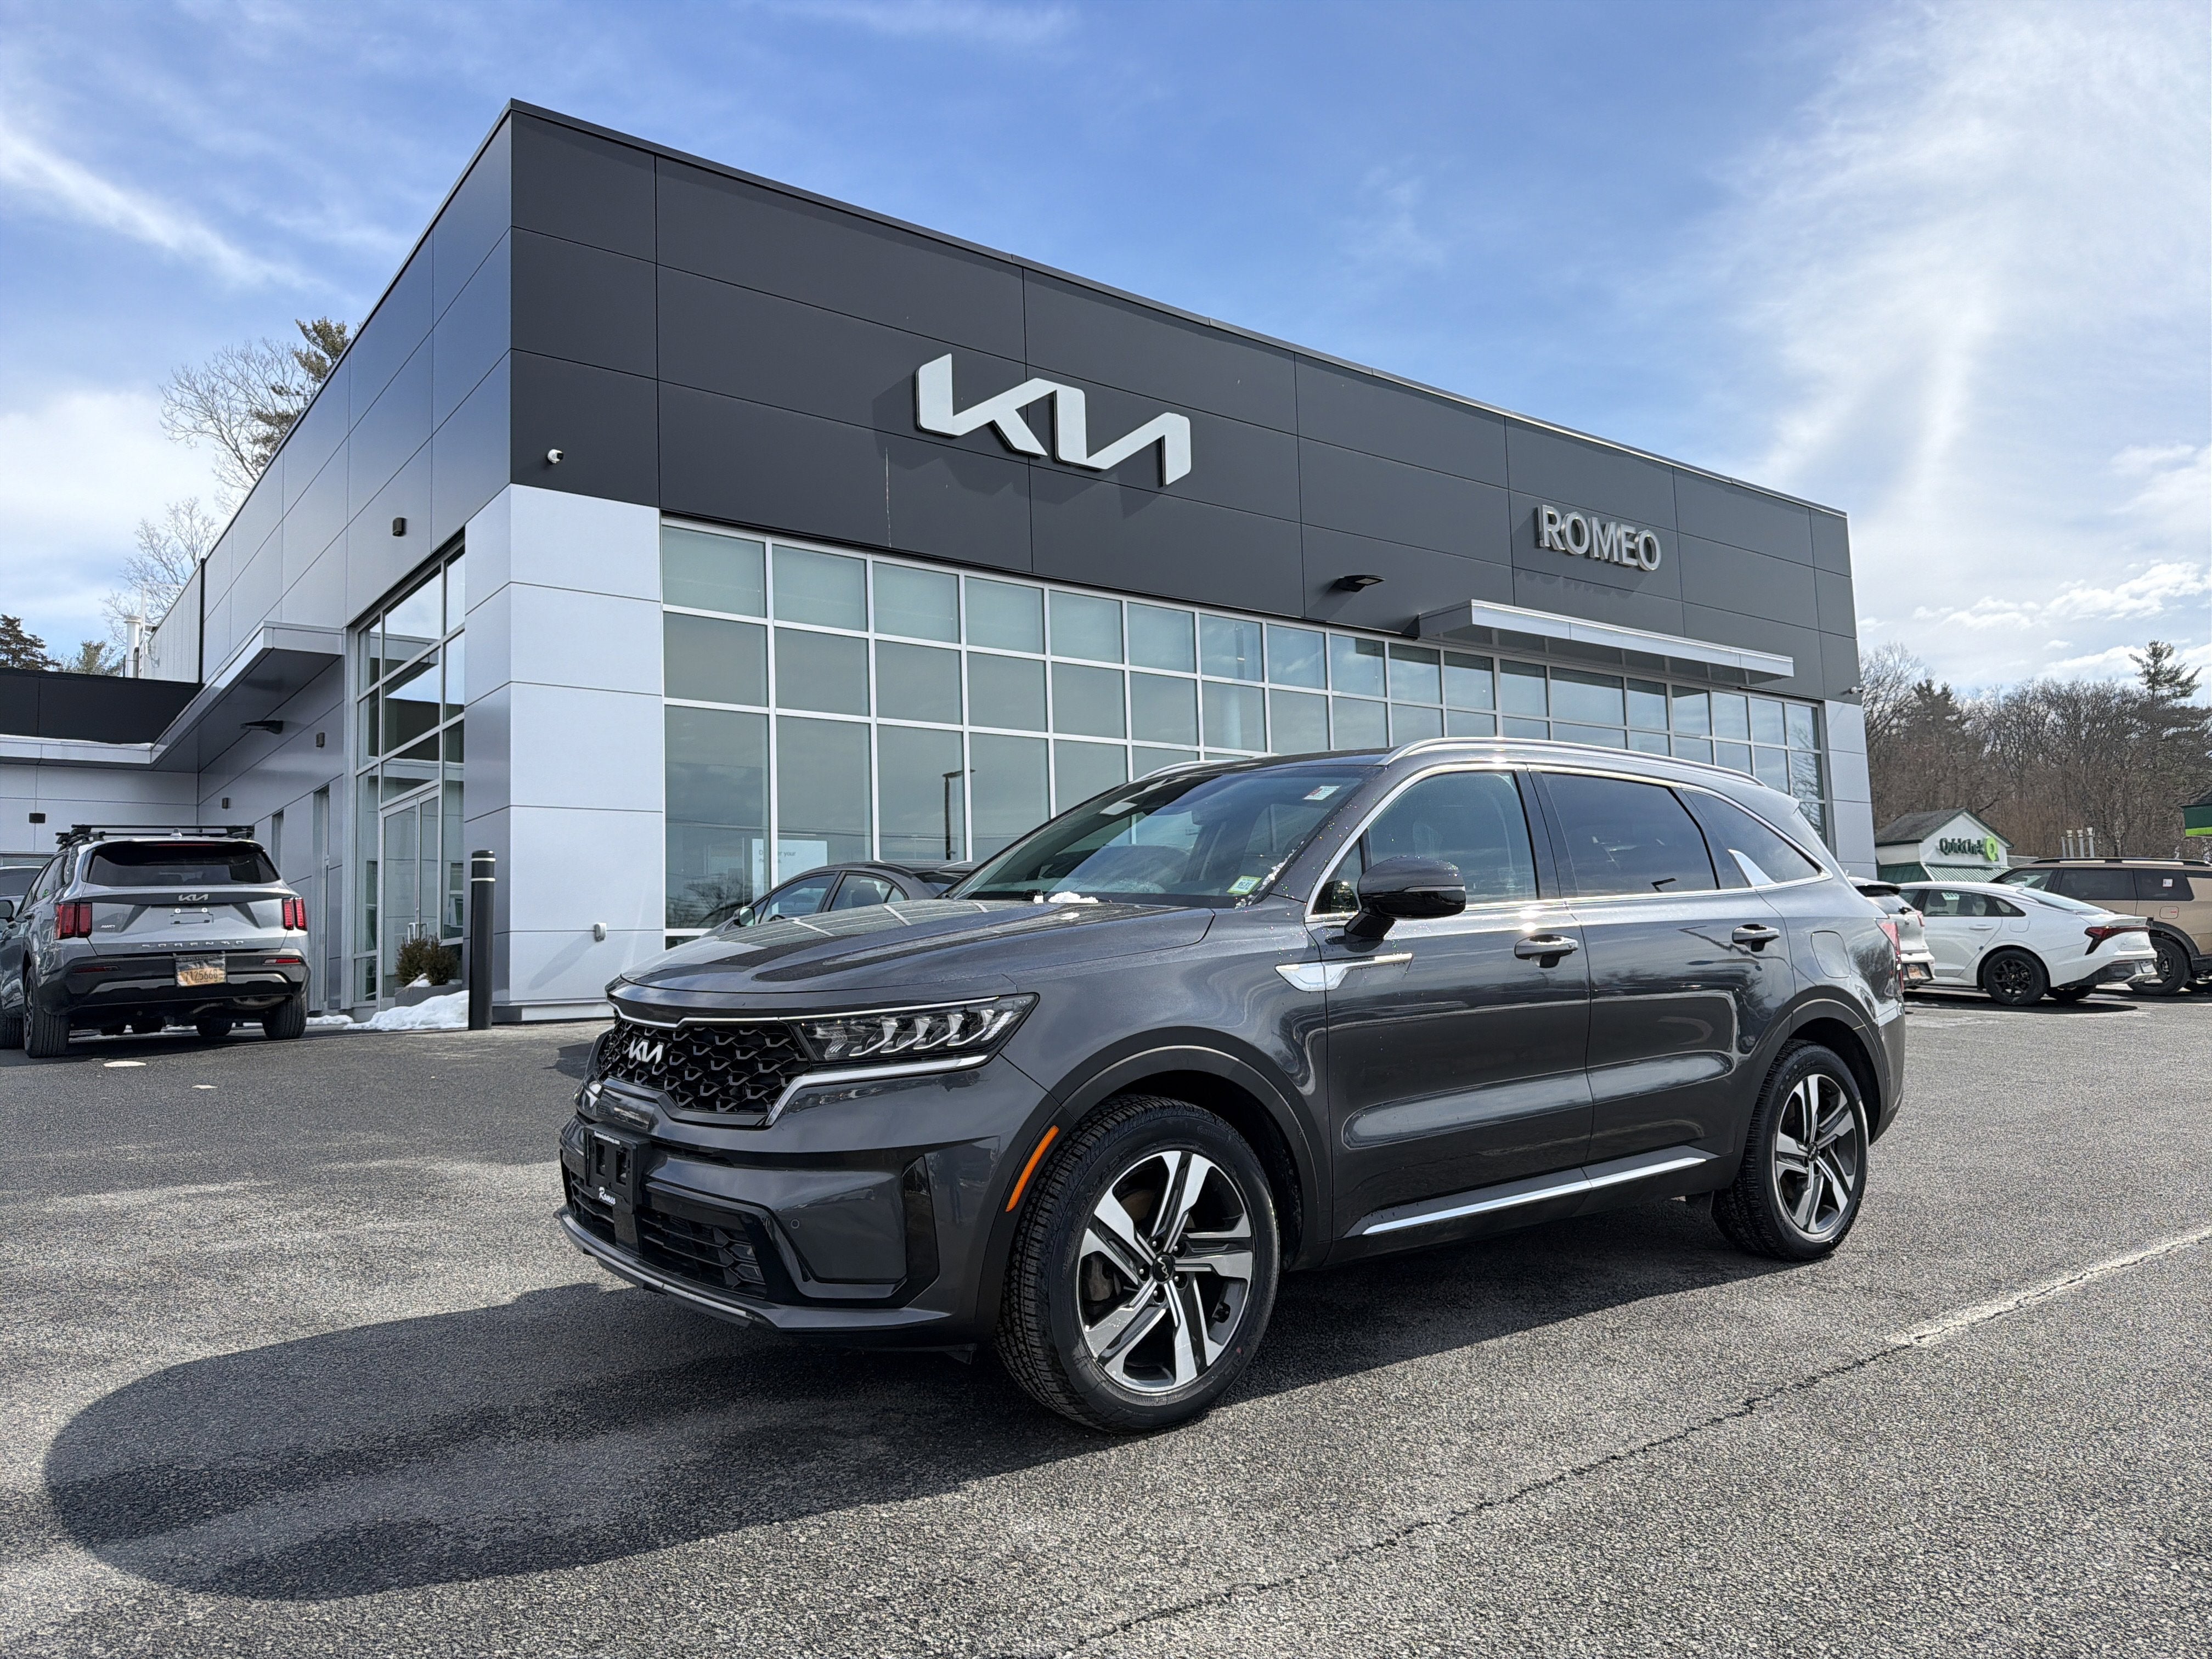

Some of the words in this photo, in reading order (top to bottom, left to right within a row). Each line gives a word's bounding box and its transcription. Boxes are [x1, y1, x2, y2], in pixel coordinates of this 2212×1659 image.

[915, 353, 1192, 486] KIA
[1538, 504, 1661, 571] ROMEO
[629, 1039, 663, 1064] KIA
